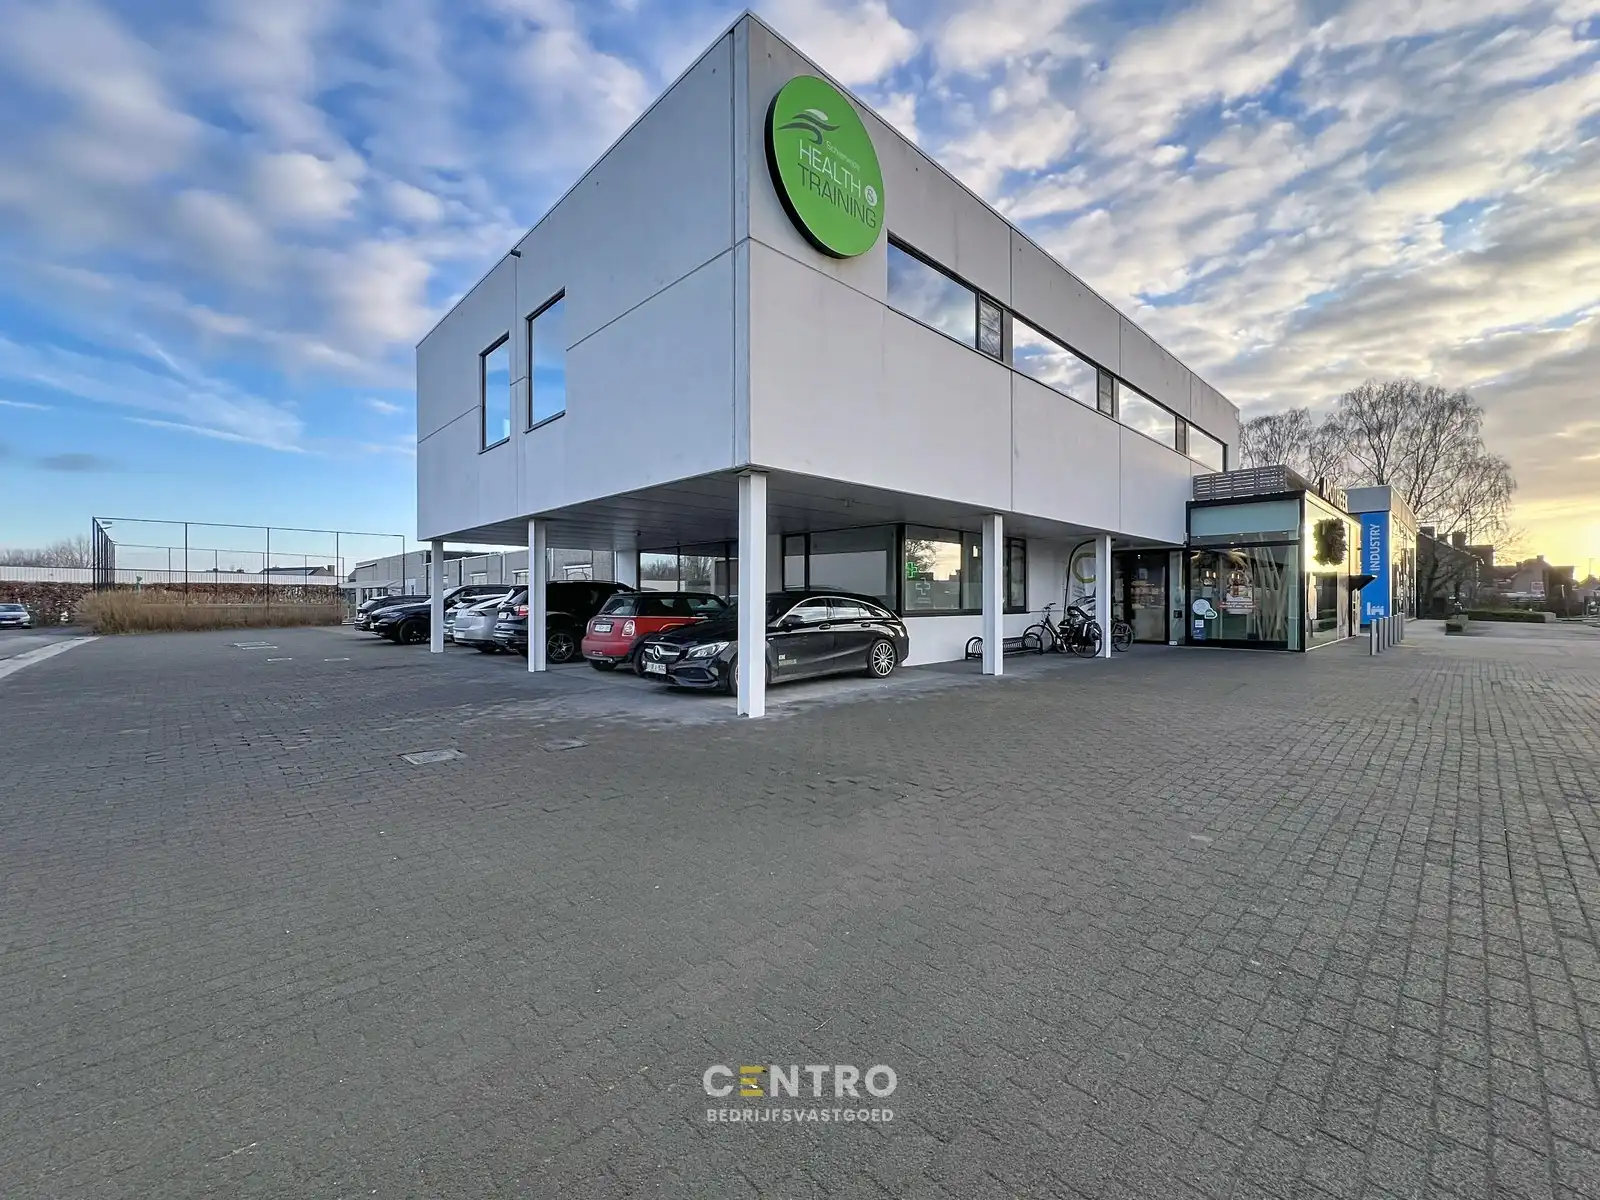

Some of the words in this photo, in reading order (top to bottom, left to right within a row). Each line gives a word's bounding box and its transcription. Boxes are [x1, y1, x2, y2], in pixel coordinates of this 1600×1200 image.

[797, 162, 876, 229] TRAINING
[799, 138, 861, 198] HEALTH
[1369, 523, 1381, 572] INDUSTRY
